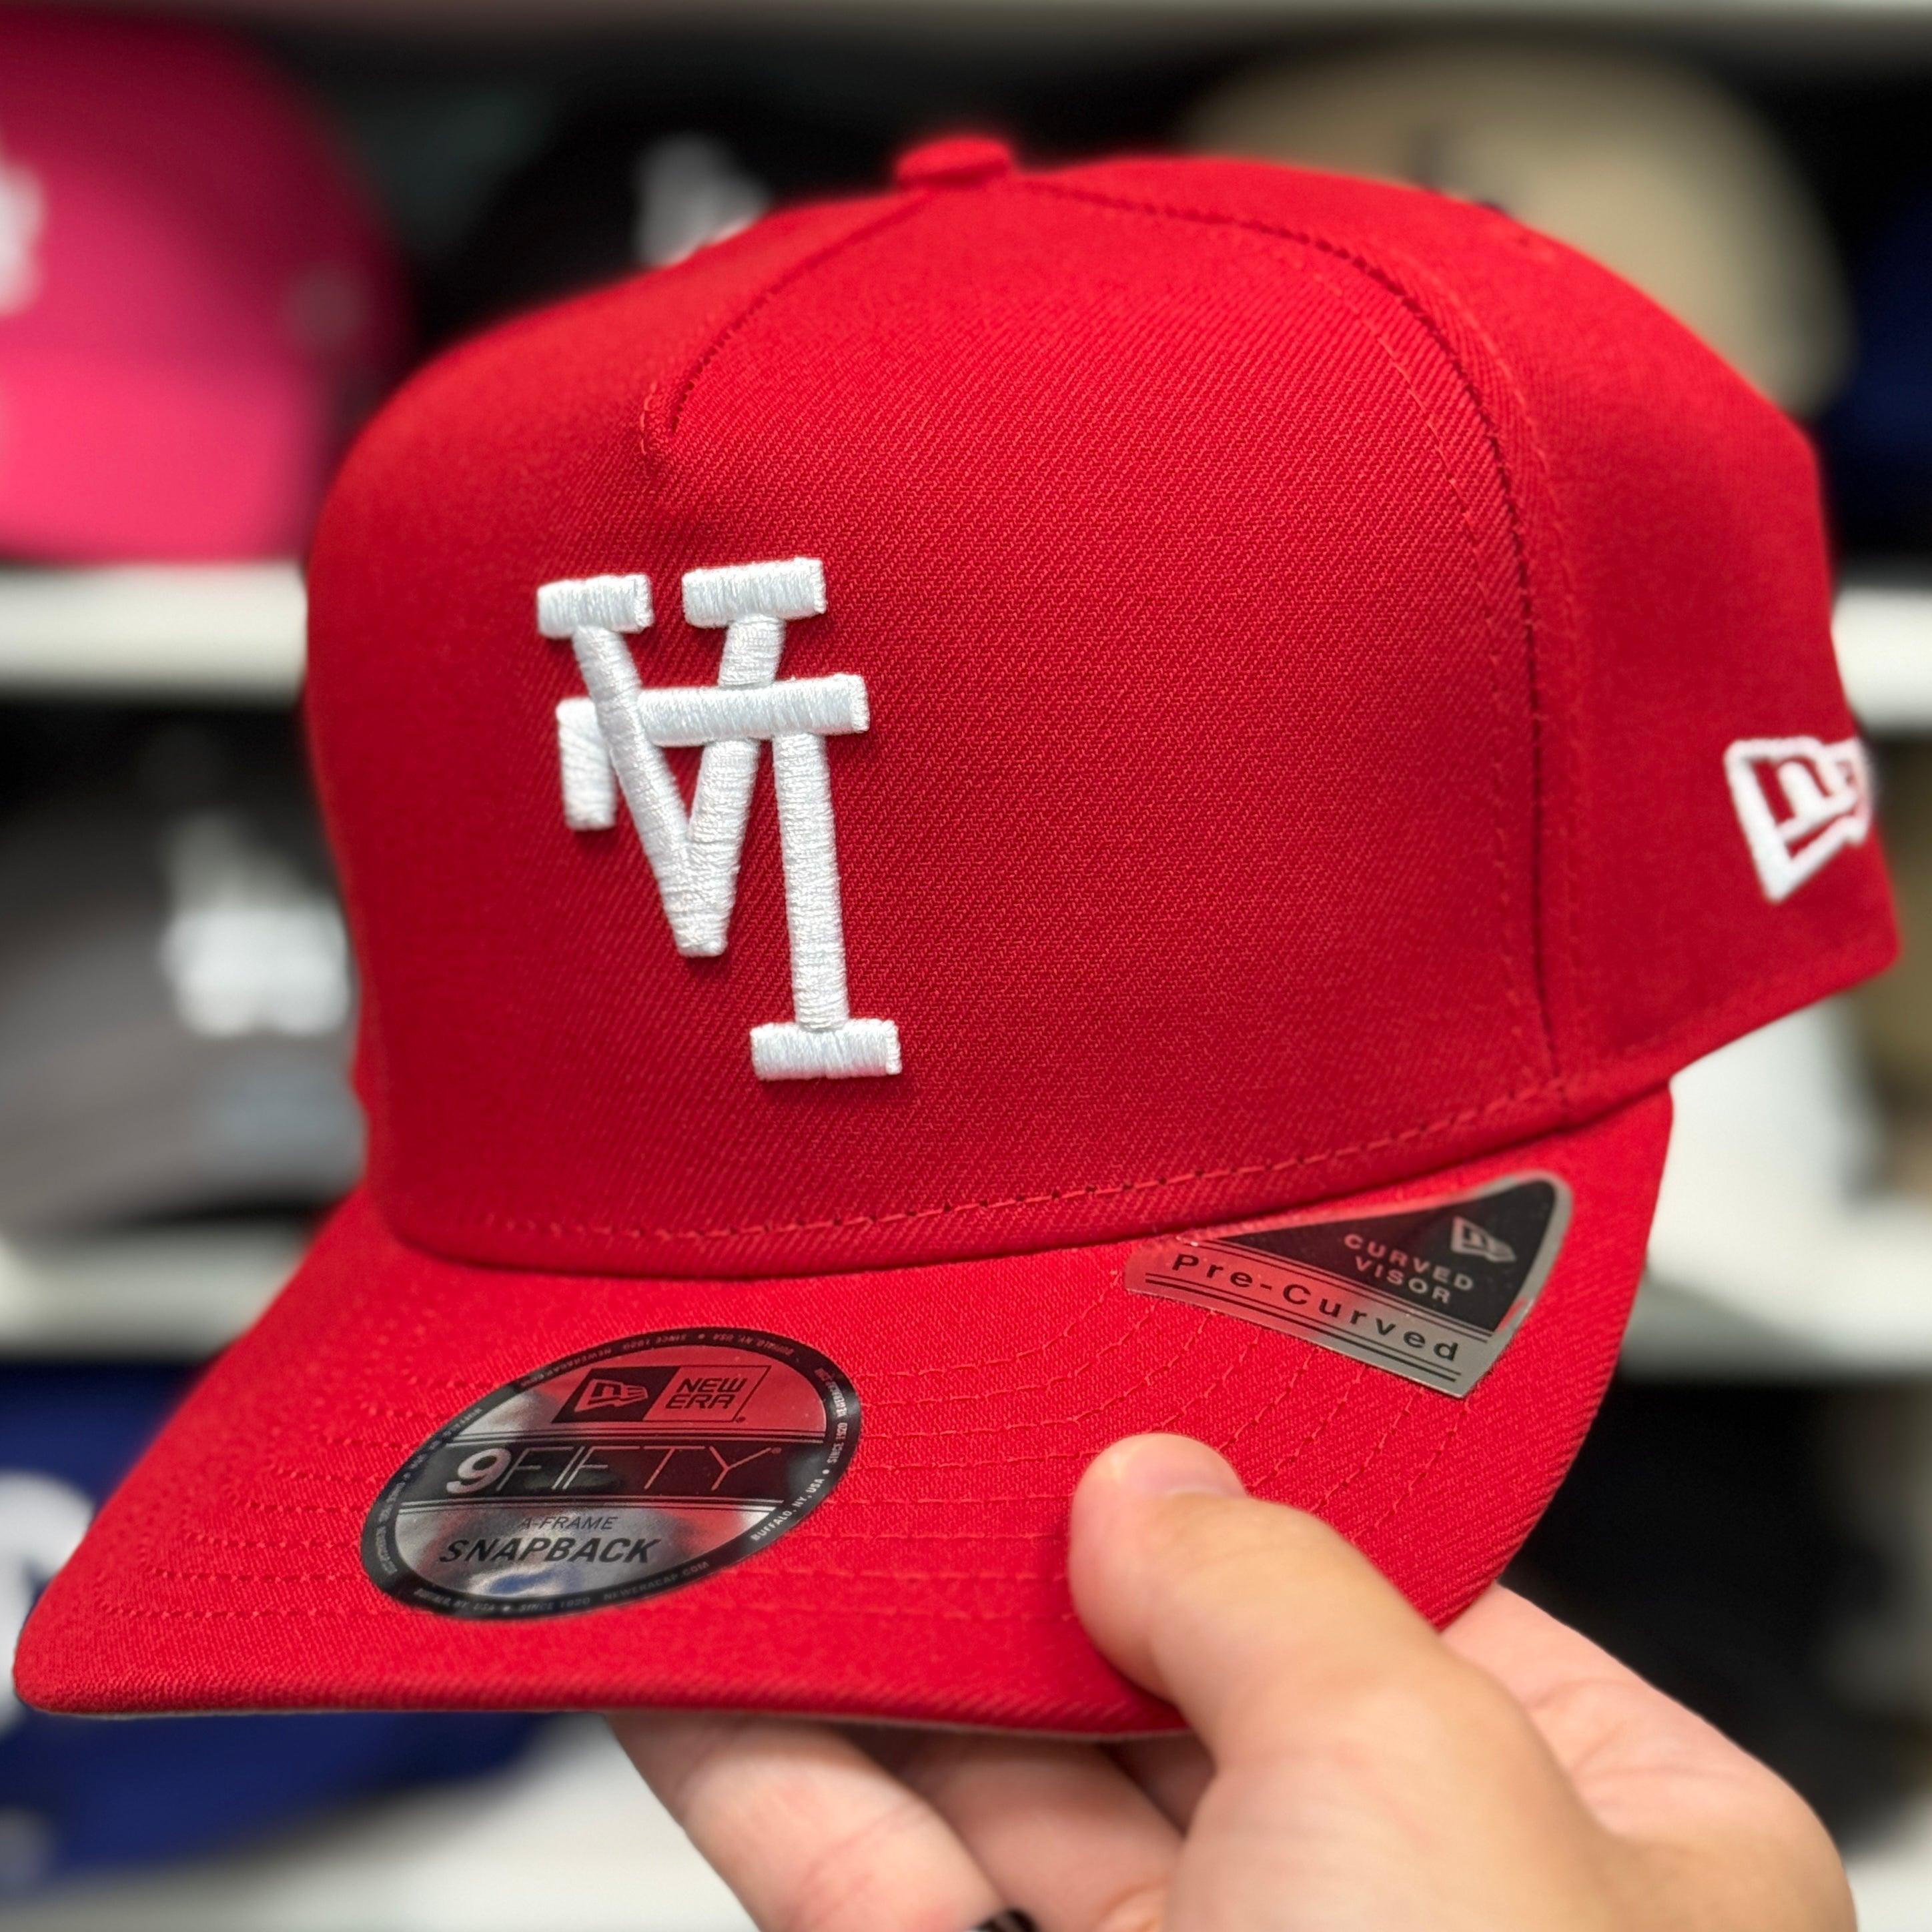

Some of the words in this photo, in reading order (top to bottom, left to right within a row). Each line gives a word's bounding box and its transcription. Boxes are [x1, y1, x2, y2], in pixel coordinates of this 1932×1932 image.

[1344, 1233, 1474, 1291] CURVED
[1355, 1256, 1451, 1304] VISOR
[1171, 1253, 1460, 1362] Pre-Curved
[676, 1377, 748, 1393] NEW
[665, 1394, 736, 1410] ERA
[810, 1478, 825, 1494] USA
[518, 1515, 618, 1532] A-FRAME
[438, 1536, 662, 1564] SNAPBACK
